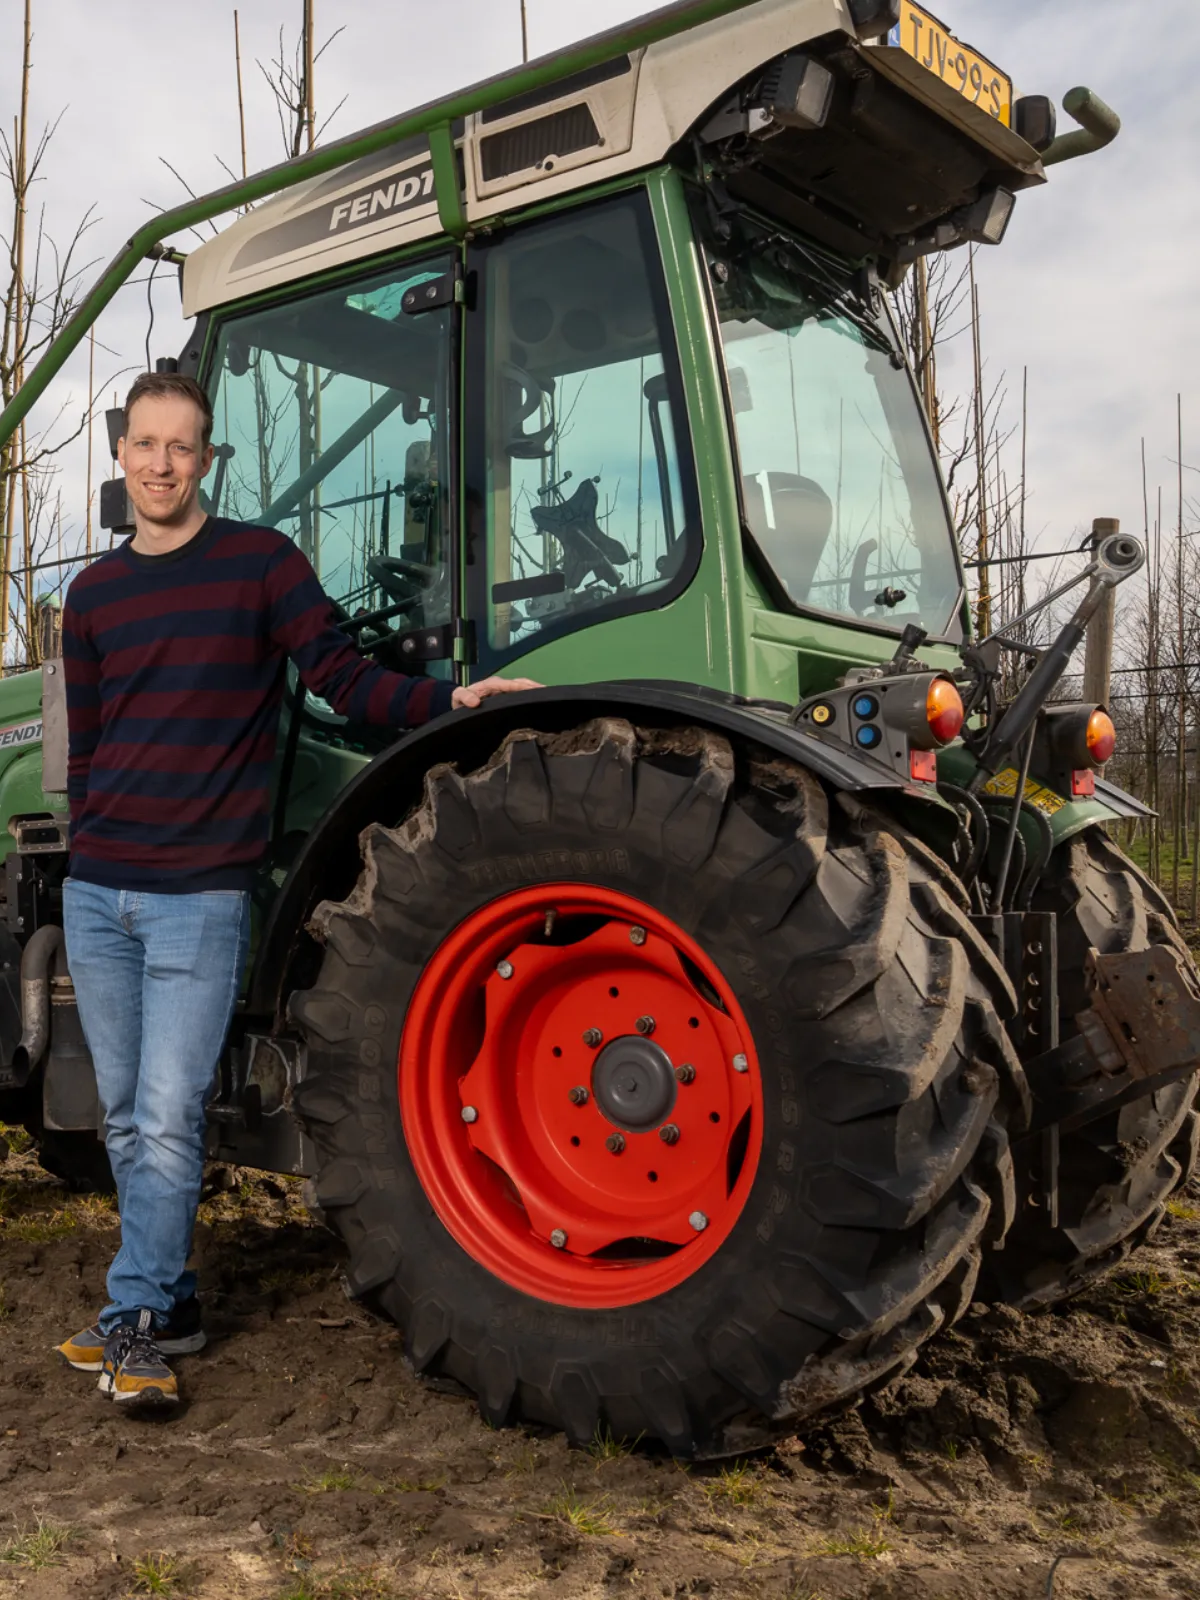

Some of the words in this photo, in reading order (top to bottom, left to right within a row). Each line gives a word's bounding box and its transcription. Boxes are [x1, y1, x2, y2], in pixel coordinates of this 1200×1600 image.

[909, 12, 1001, 118] TJV-99-S
[329, 169, 435, 231] FENDT
[358, 1003, 398, 1190] TM800
